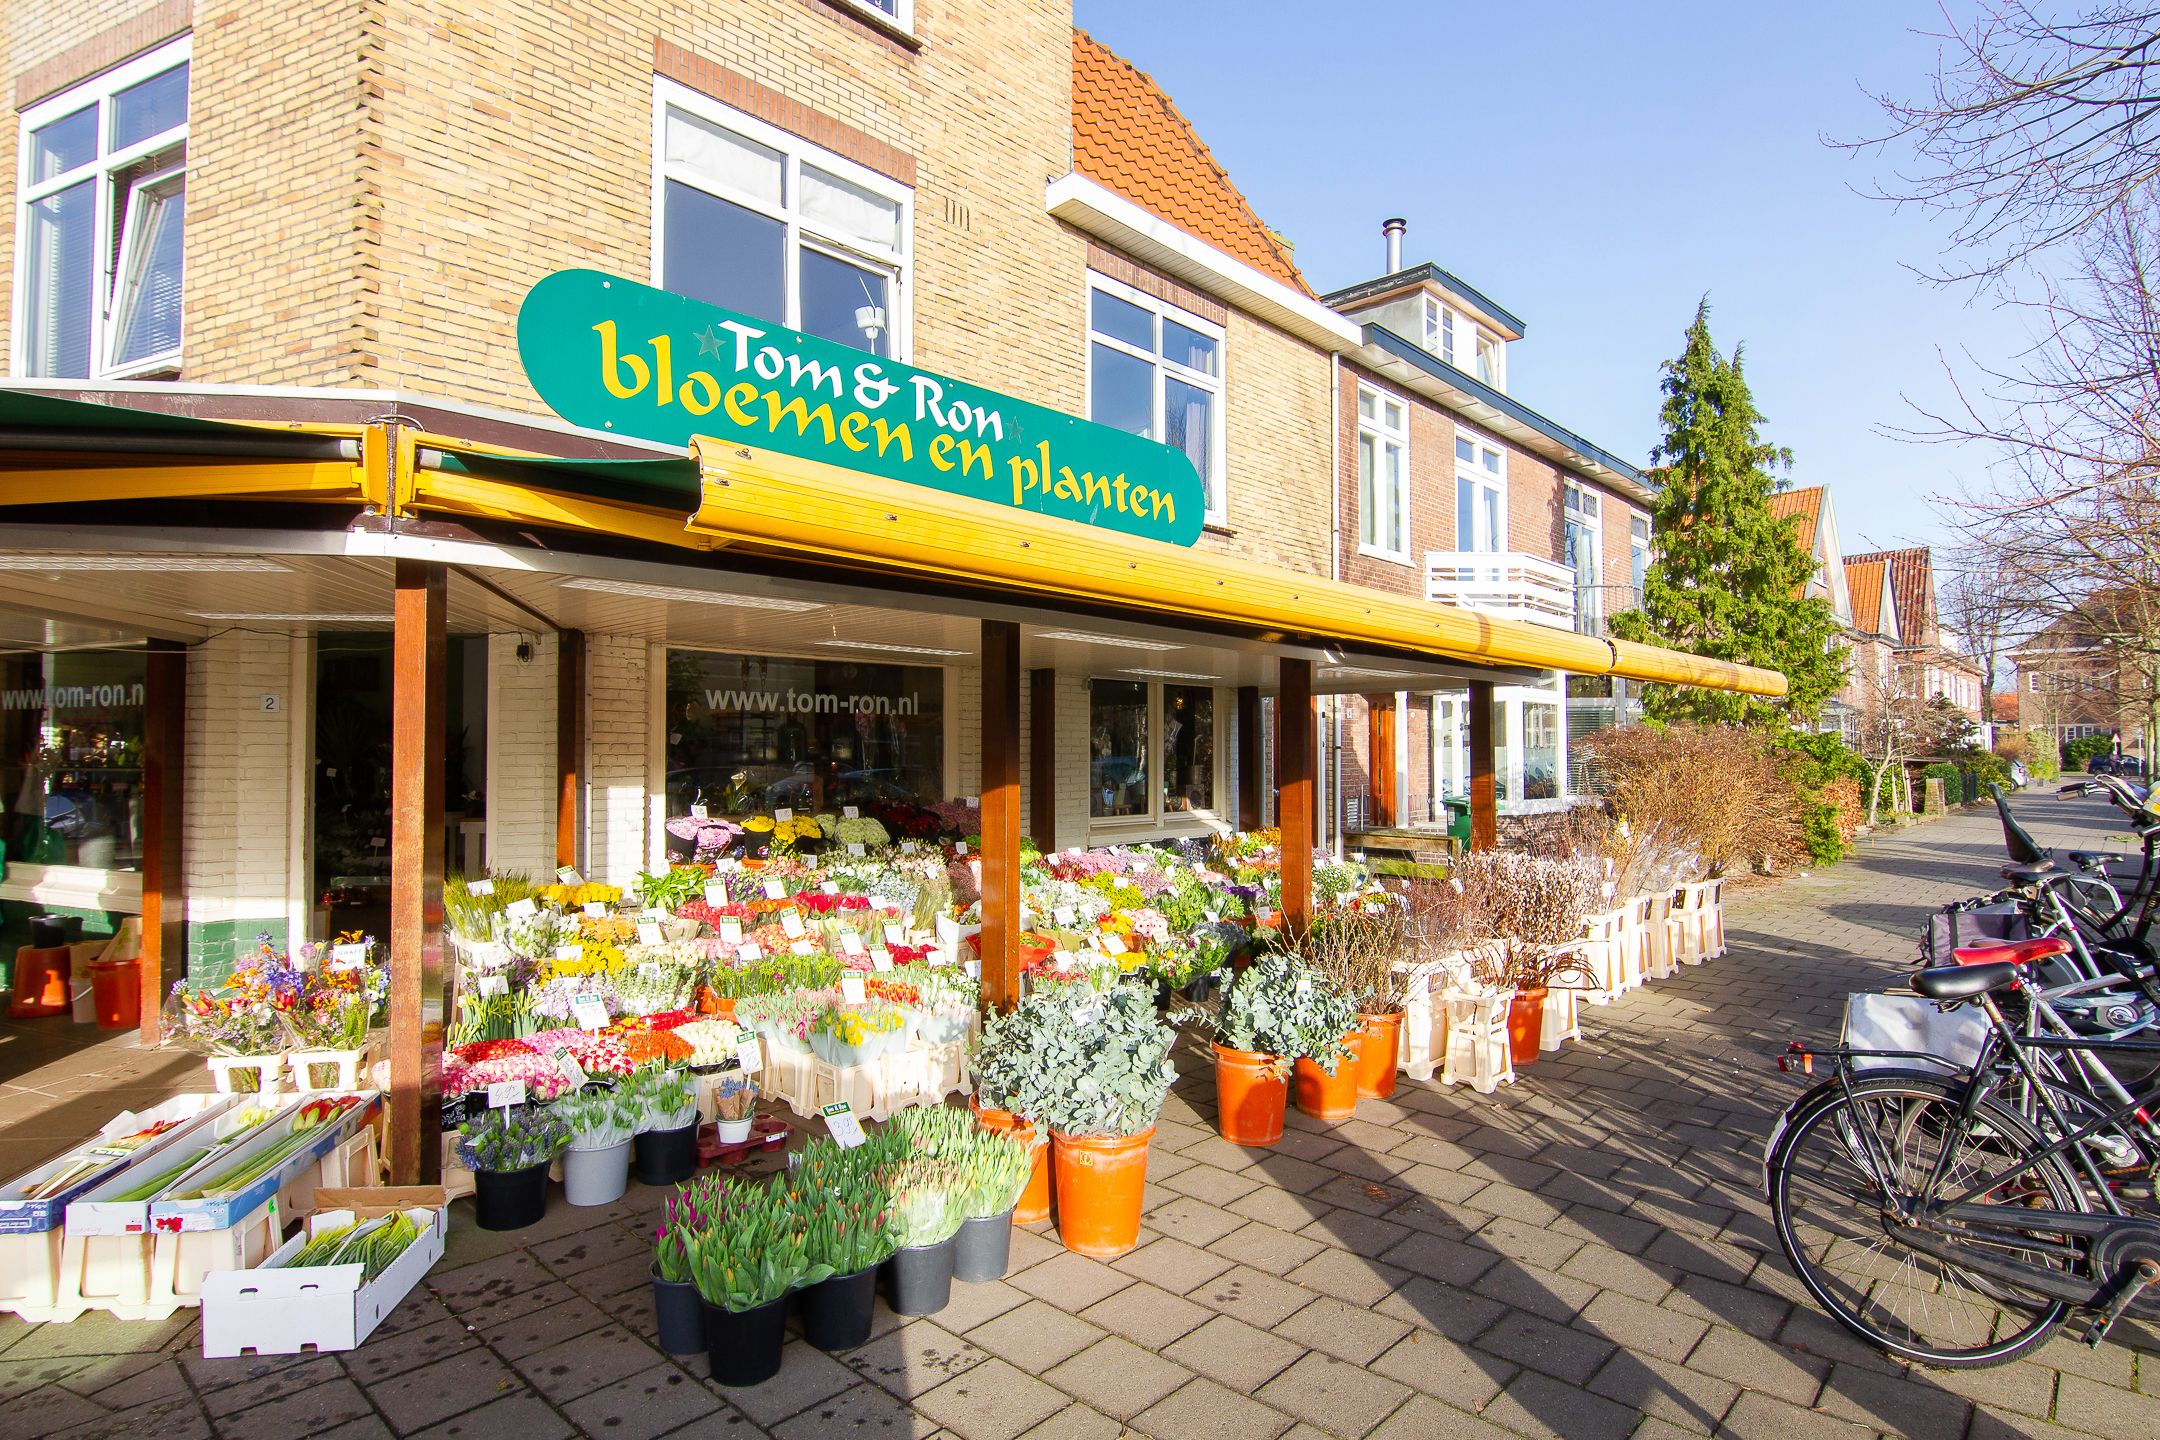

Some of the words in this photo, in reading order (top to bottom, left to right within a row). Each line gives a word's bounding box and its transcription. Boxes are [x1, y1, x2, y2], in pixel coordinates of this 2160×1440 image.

[718, 319, 843, 398] Tom
[853, 362, 901, 409] &
[907, 374, 1004, 441] Ron
[592, 319, 914, 463] bloemen
[929, 433, 994, 481] en
[1007, 439, 1176, 524] planten
[266, 697, 275, 710] 2
[705, 688, 919, 716] www.tom-ron.nl
